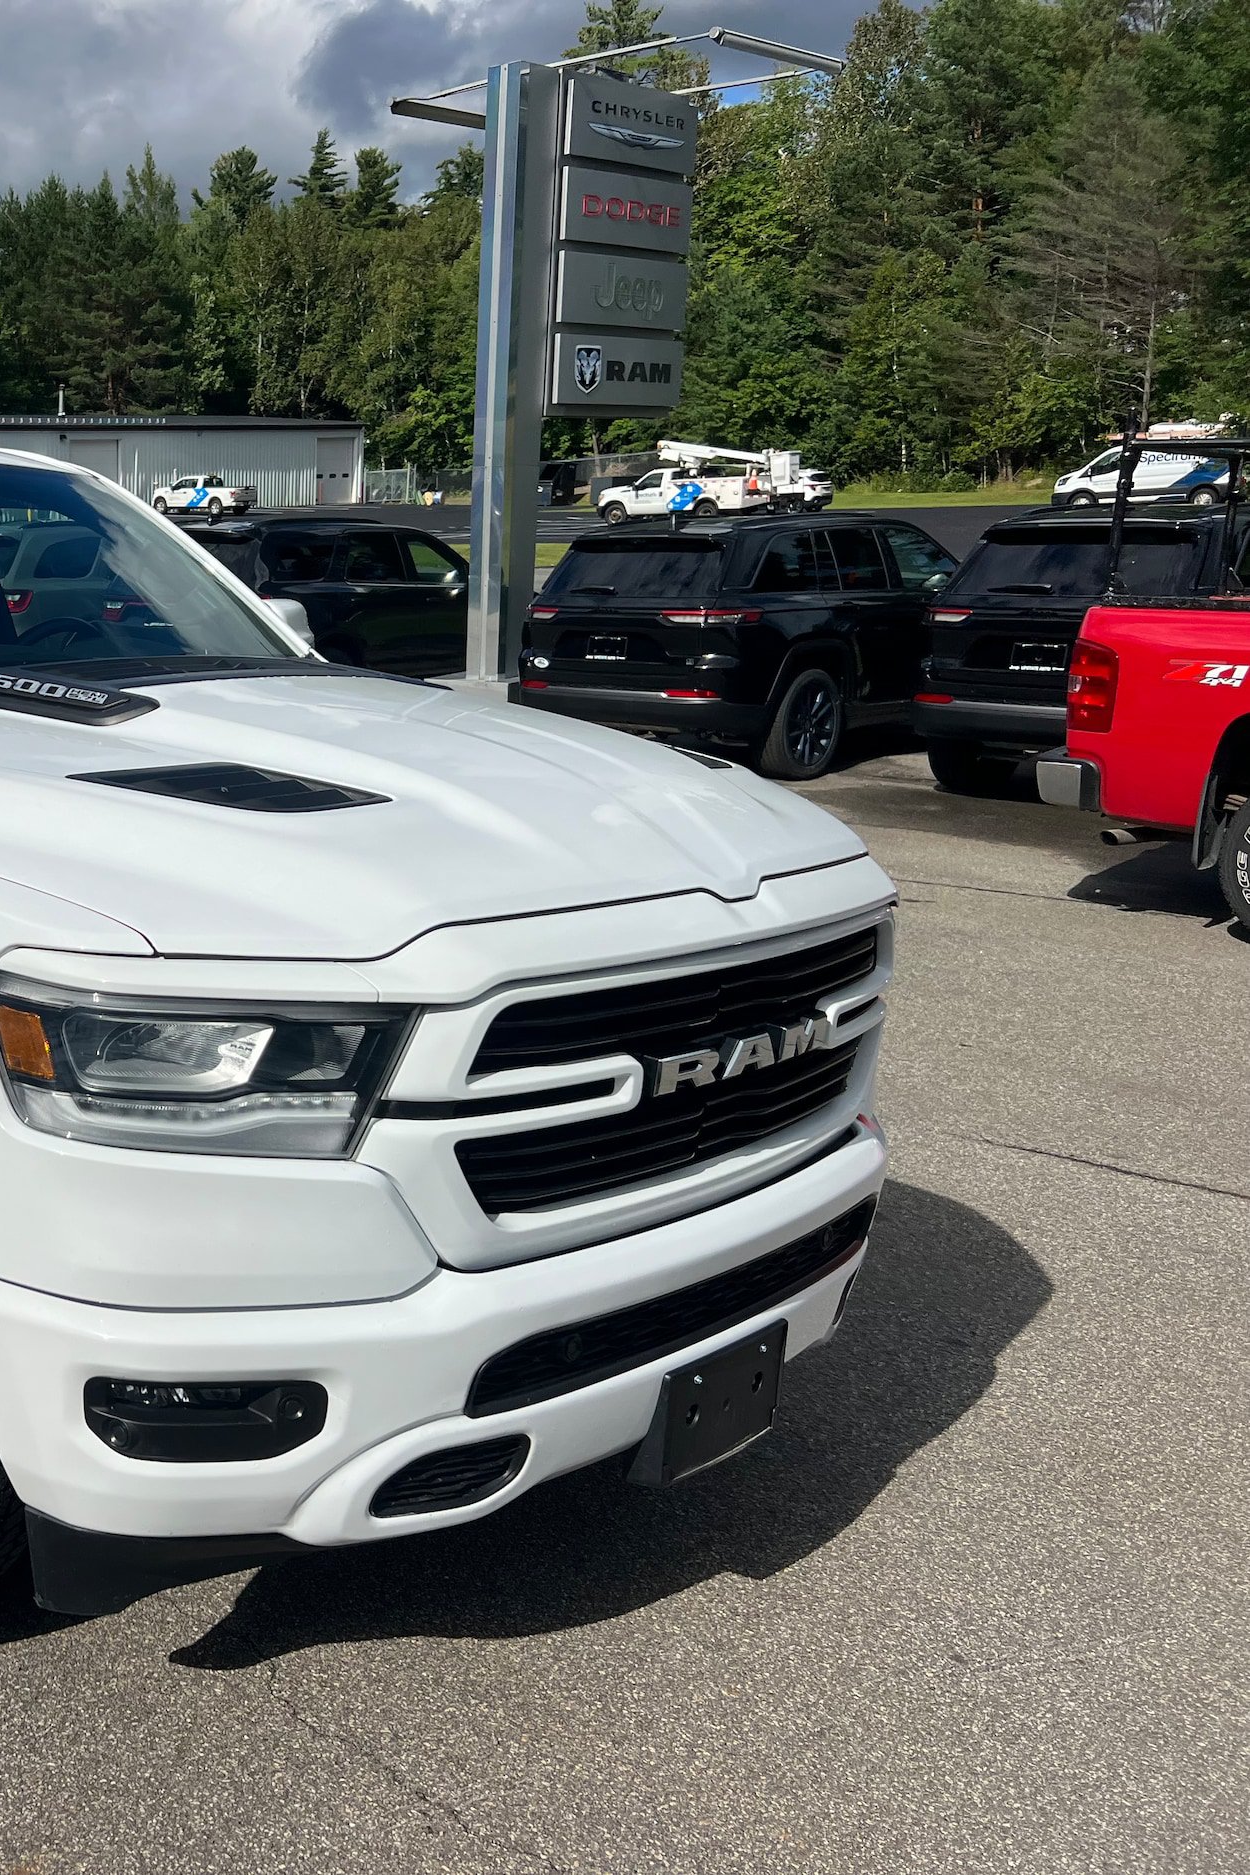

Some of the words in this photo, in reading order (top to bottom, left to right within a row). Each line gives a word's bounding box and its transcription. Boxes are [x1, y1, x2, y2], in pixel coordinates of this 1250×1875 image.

[591, 100, 685, 130] CHRYSLER
[581, 194, 681, 228] DODGE
[591, 262, 664, 321] Jeep
[606, 360, 672, 384] RAM
[1162, 659, 1250, 681] Z71
[653, 1010, 830, 1098] RAM
